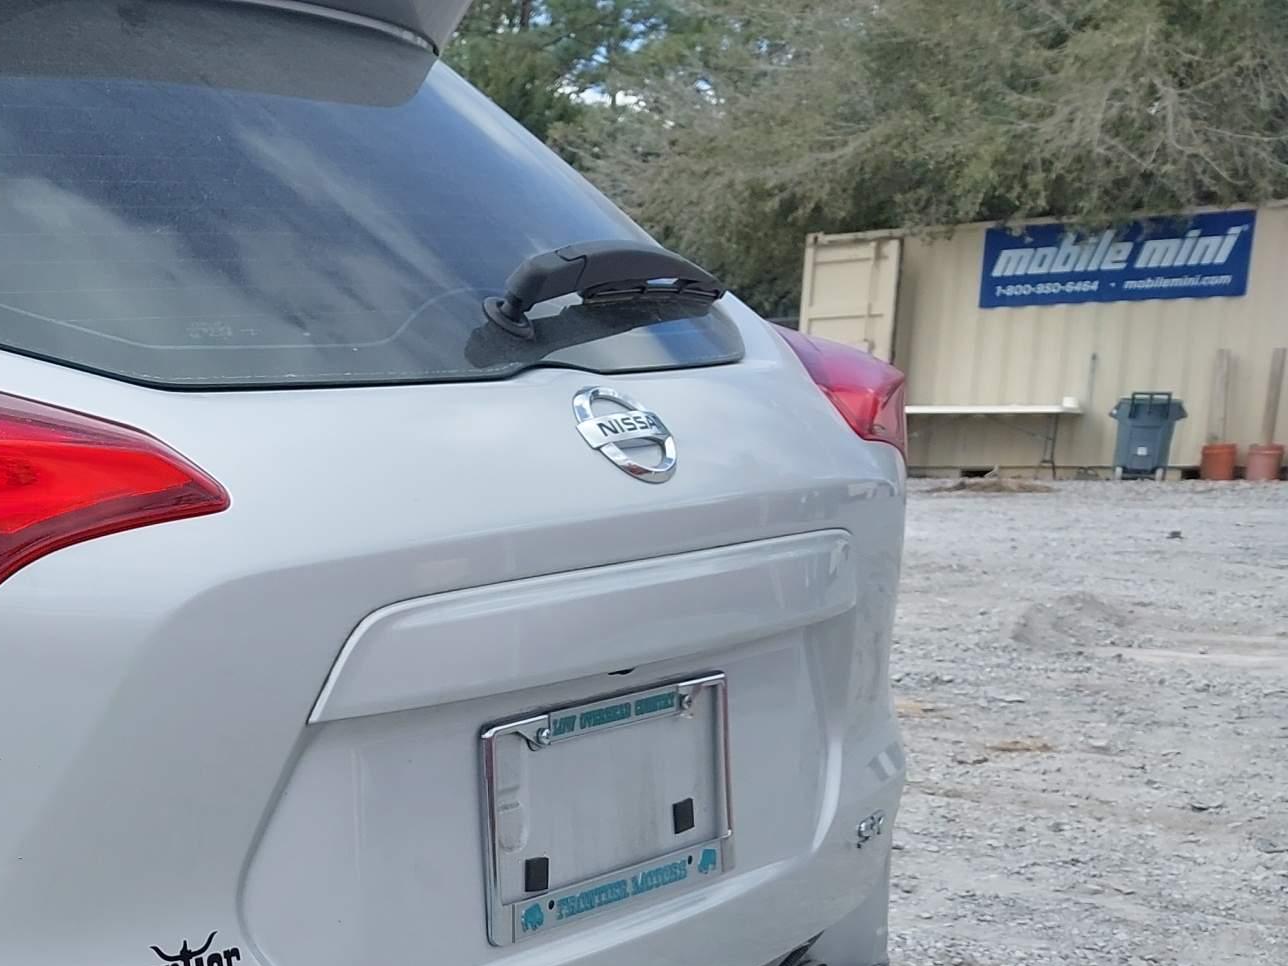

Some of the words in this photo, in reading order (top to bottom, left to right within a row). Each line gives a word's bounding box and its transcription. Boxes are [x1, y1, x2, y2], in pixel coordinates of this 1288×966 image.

[991, 230, 1133, 277] mobile
[1134, 226, 1241, 268] mini
[1123, 274, 1232, 290] mobilemini.com
[597, 415, 659, 437] NISSA
[556, 879, 630, 920] FRONTIER
[631, 859, 688, 897] MOTORS
